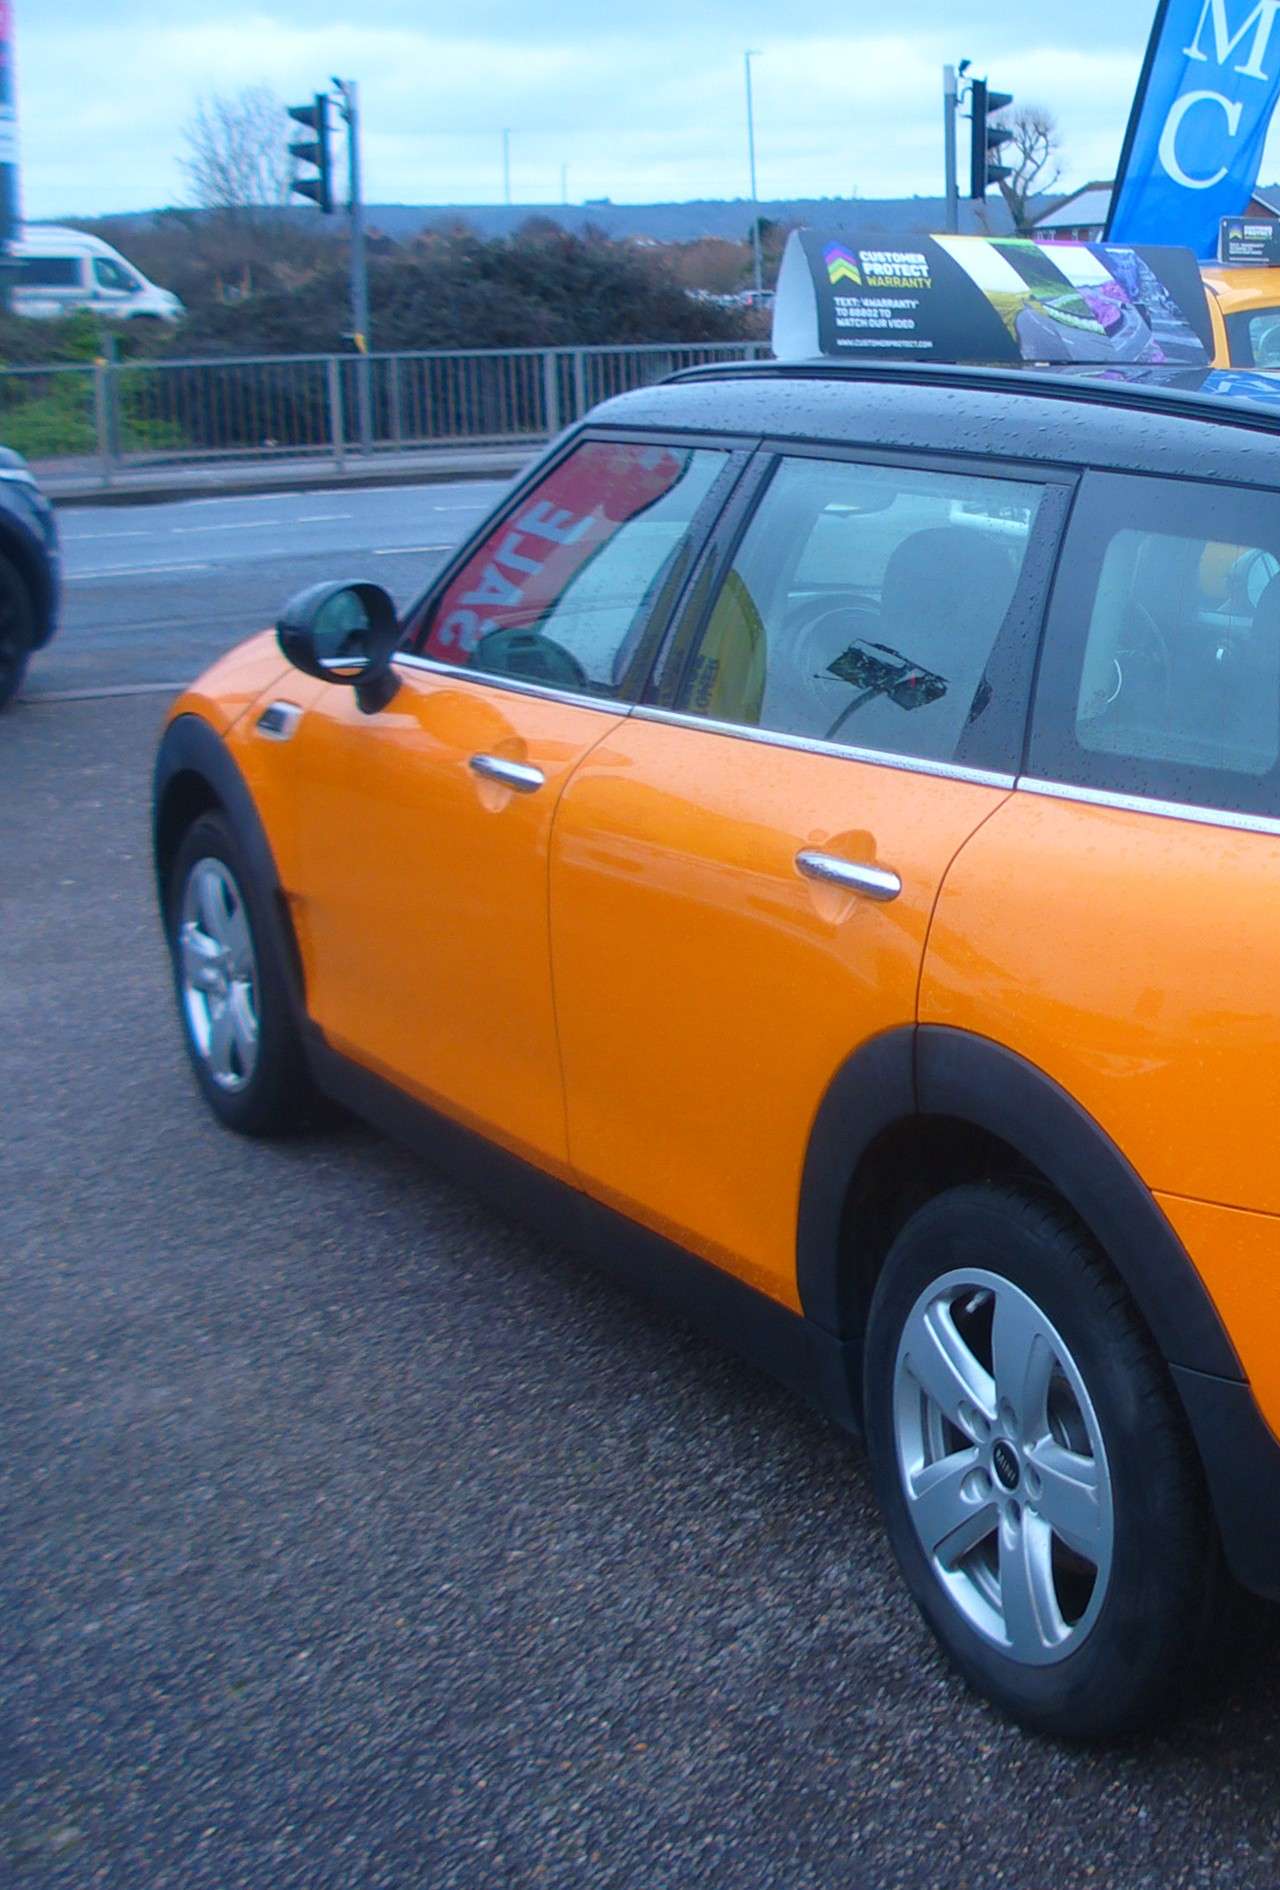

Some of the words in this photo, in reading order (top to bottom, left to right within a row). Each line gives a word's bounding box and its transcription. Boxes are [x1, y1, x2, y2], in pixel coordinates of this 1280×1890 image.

[859, 250, 926, 264] CUSTOMER
[862, 262, 929, 276] PROTECT
[867, 276, 932, 288] WARRANTY
